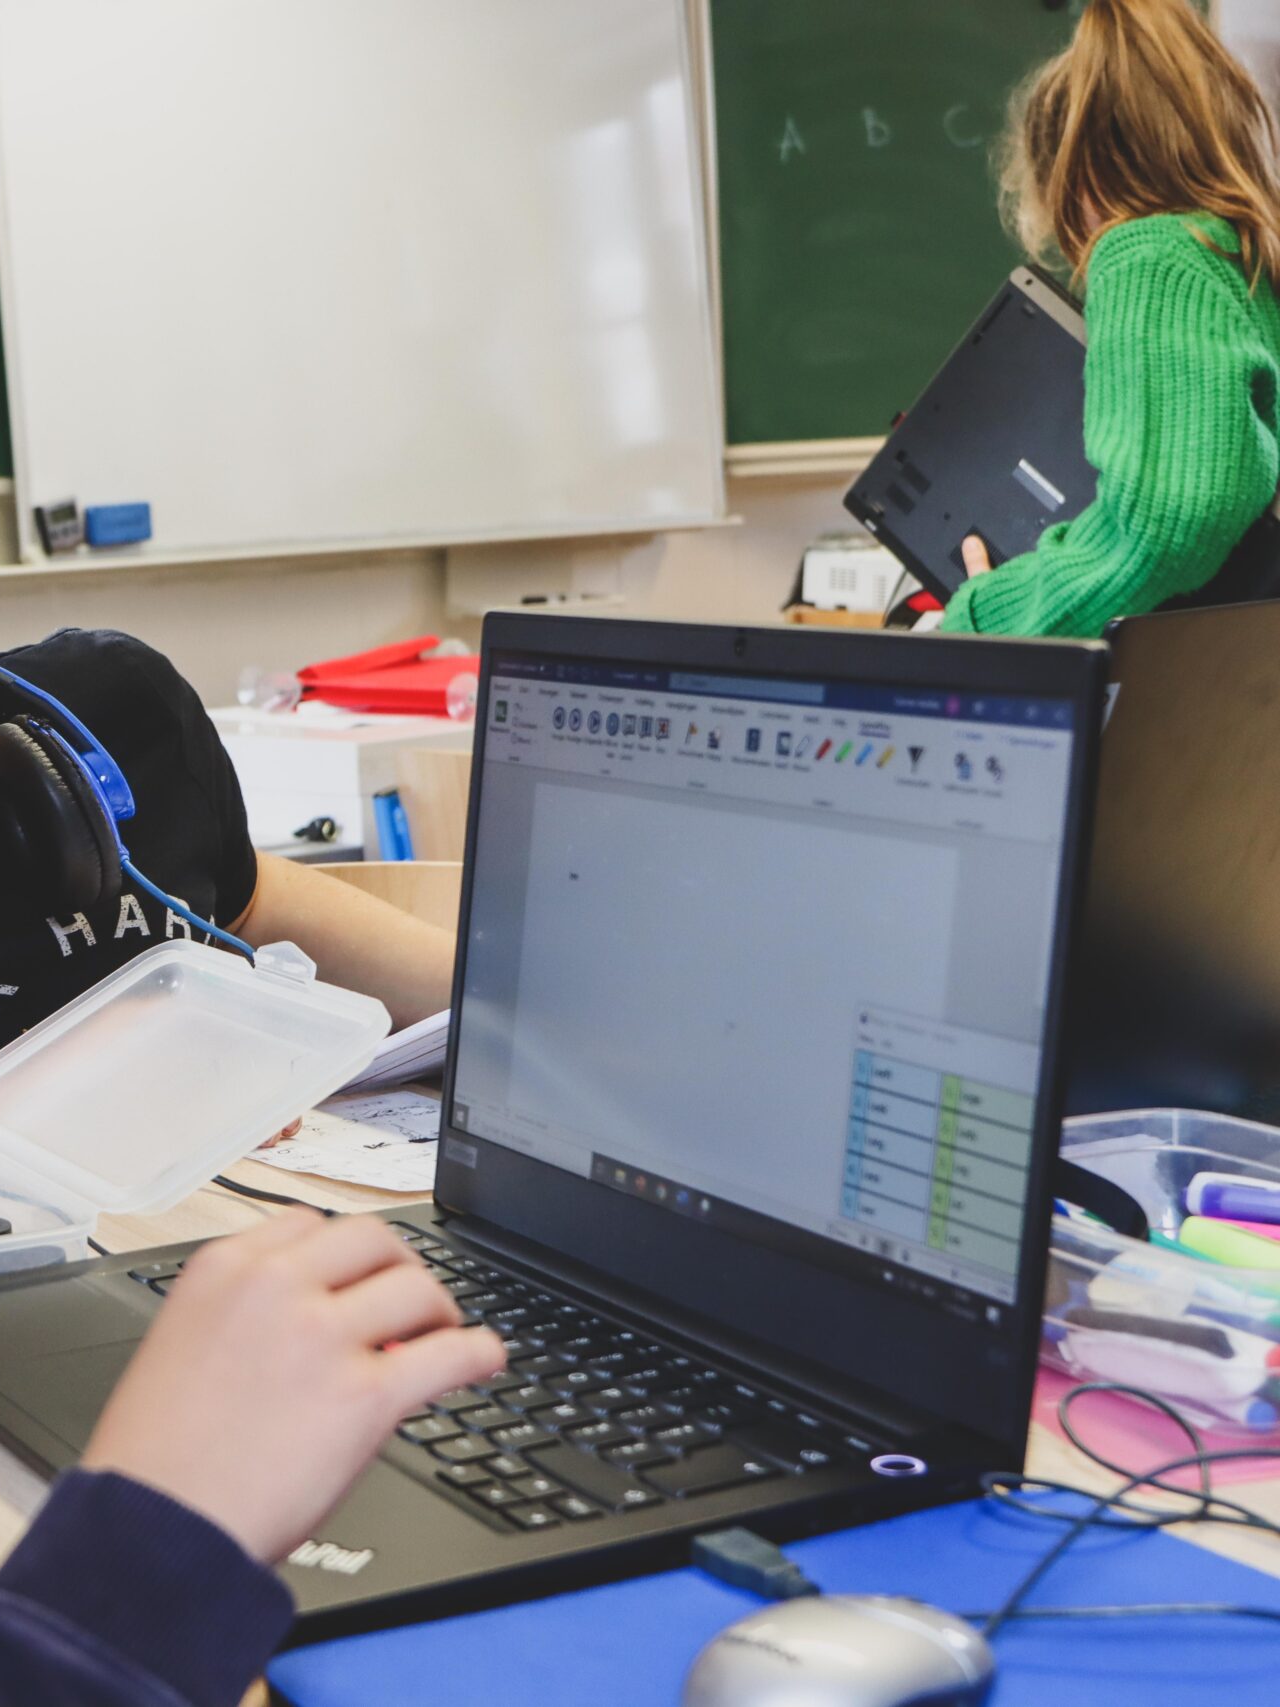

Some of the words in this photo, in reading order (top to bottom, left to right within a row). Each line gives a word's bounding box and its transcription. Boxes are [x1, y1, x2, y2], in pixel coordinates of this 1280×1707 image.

[778, 114, 805, 164] A
[942, 103, 984, 148] C
[44, 894, 219, 958] HAR
